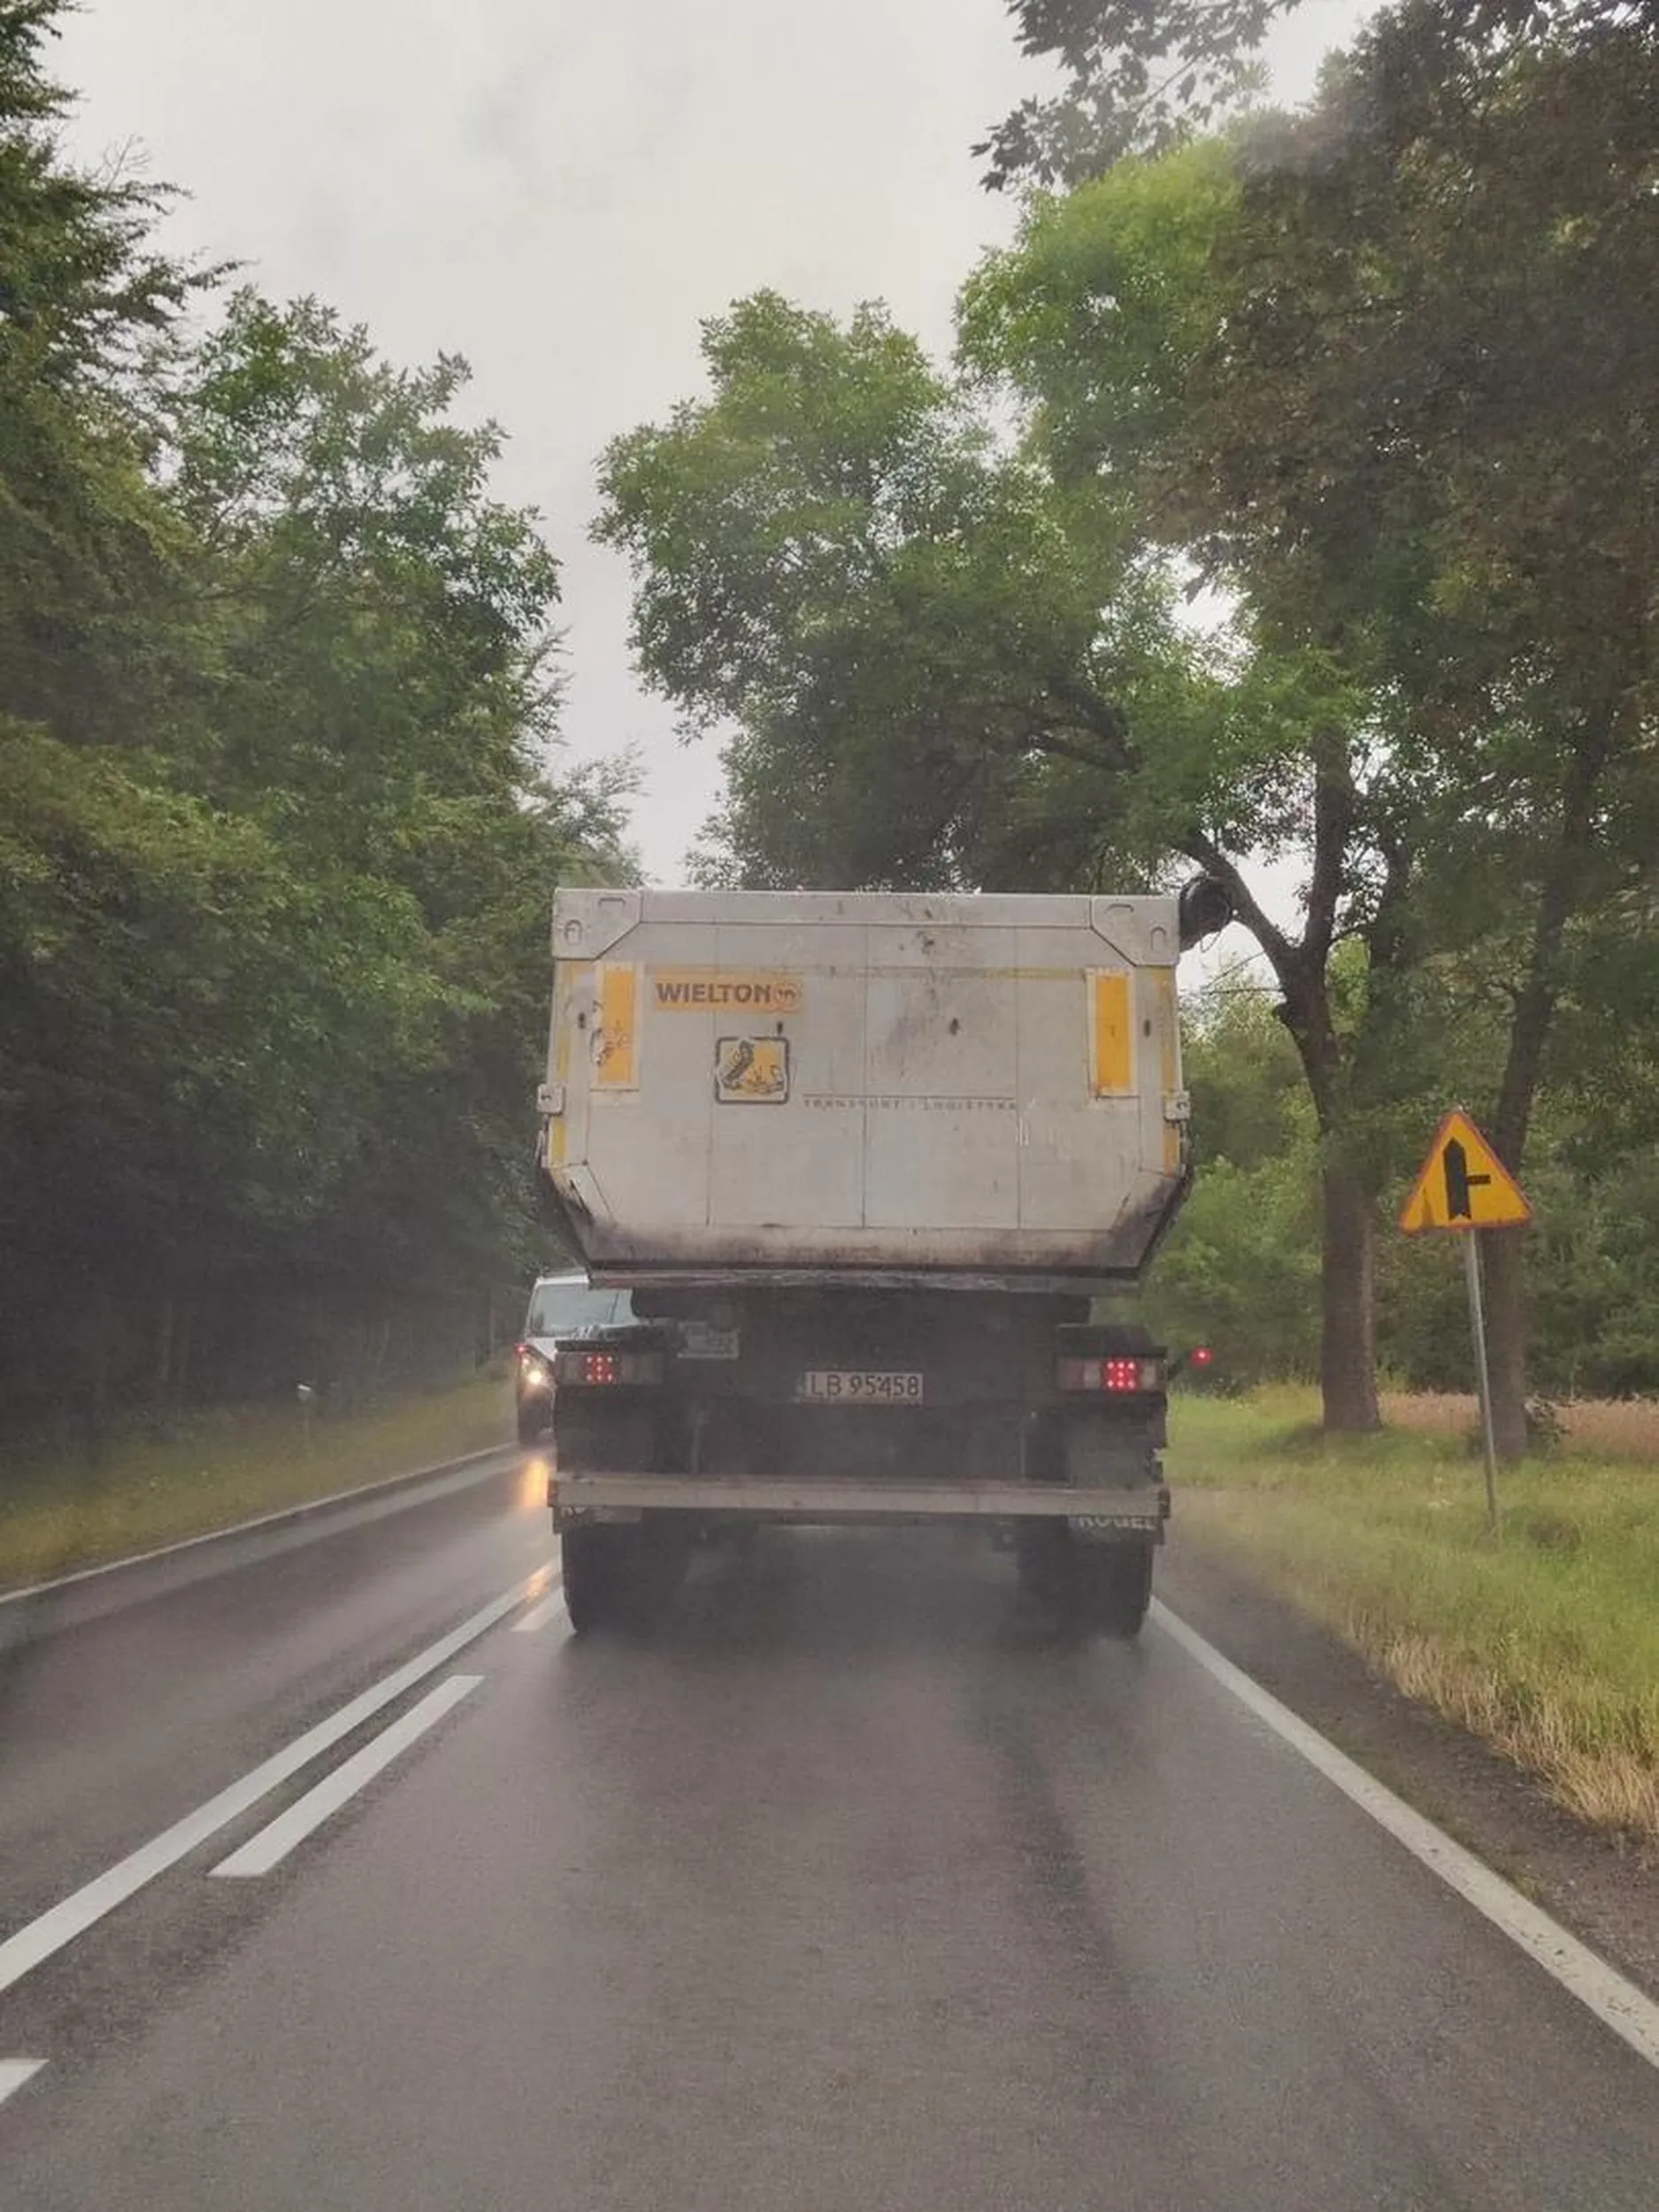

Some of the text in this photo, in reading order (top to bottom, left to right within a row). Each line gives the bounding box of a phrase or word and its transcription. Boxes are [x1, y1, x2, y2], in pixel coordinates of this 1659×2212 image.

[656, 982, 771, 1003] WIELTON
[810, 1374, 919, 1397] LB 95458
